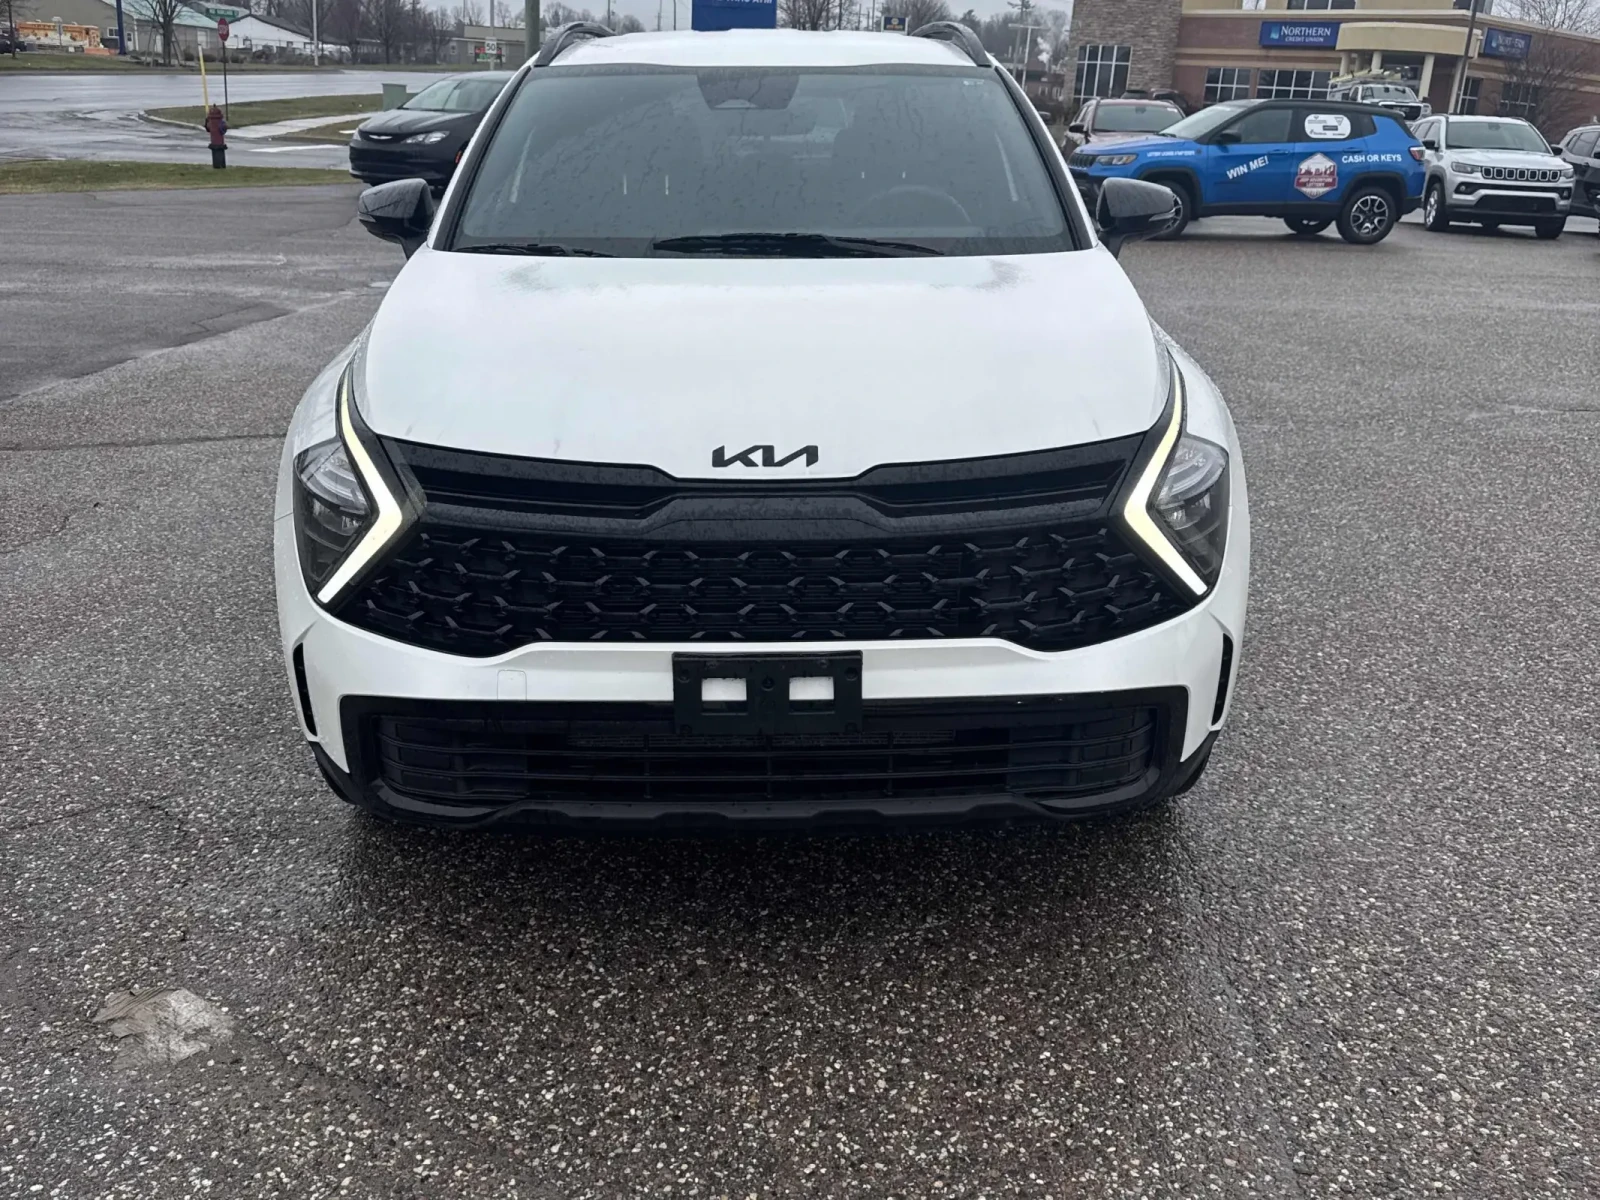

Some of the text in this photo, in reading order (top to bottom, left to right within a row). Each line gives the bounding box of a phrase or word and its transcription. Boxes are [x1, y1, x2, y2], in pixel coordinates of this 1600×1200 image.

[486, 43, 496, 51] 50
[1341, 154, 1402, 163] CASH OR KEYS
[1226, 155, 1270, 179] WIN ME!
[711, 444, 819, 468] KIA
